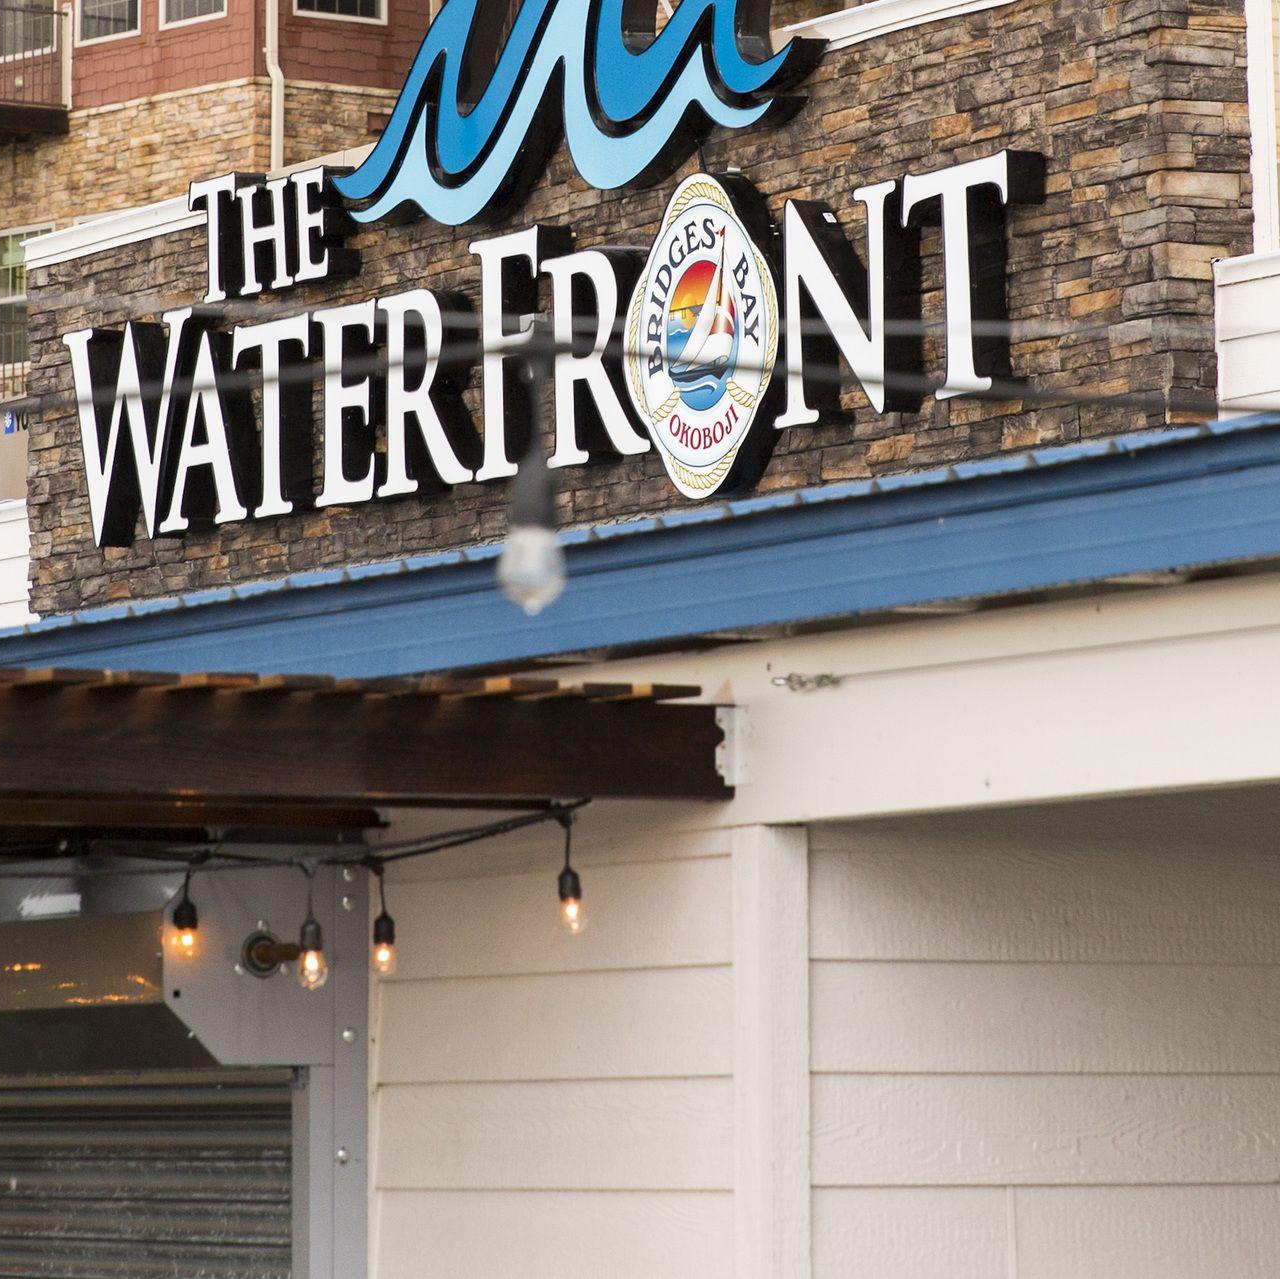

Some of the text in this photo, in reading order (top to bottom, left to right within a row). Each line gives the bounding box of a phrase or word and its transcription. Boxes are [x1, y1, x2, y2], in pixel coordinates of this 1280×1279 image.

[188, 166, 338, 304] THE
[646, 217, 760, 379] BRIDGES BAY
[63, 150, 1016, 547] WATERFRONT
[668, 403, 740, 451] OKOBOJI
